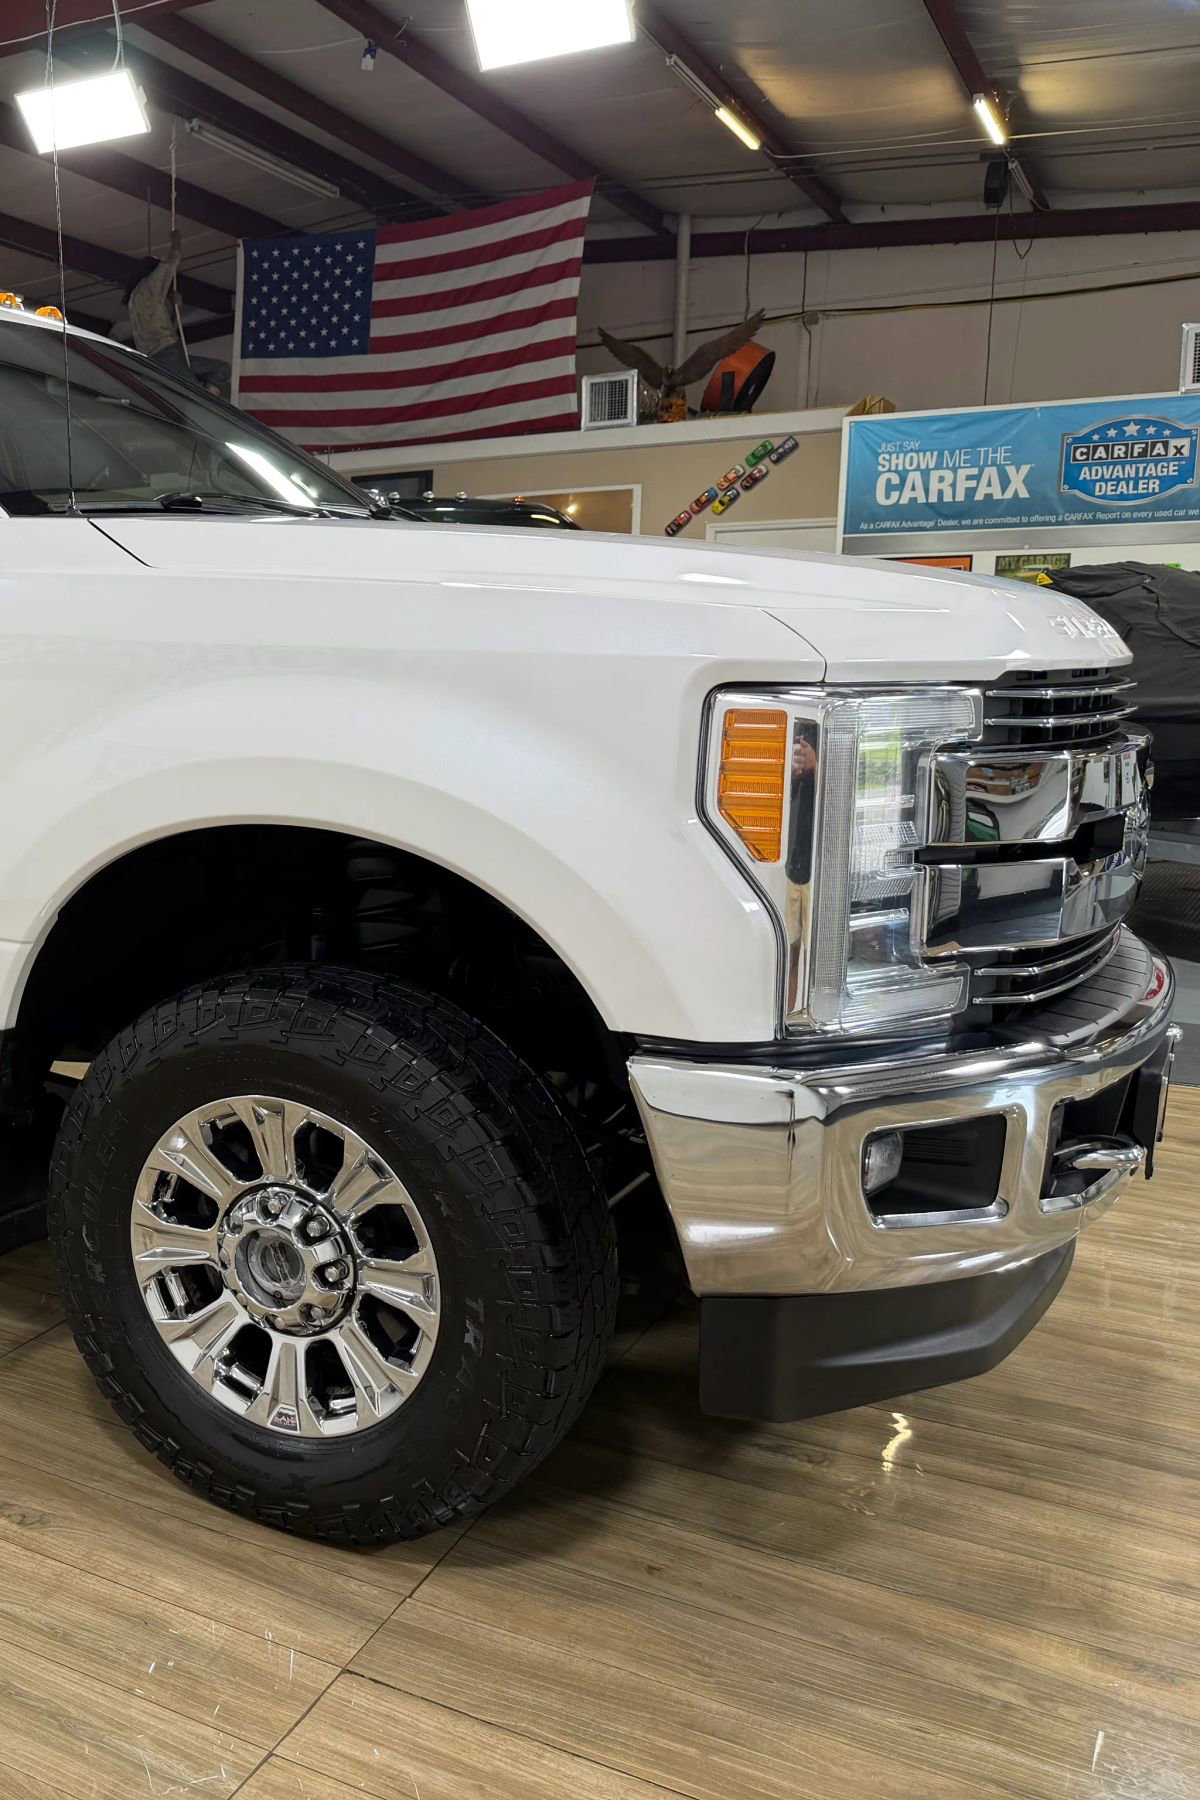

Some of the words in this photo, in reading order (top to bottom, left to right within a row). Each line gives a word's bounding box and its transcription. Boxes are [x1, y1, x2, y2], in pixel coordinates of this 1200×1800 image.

[880, 442, 900, 453] JUST
[903, 440, 920, 451] SAY
[1075, 442, 1186, 461] CARFAX
[878, 451, 938, 472] SHOW
[943, 449, 972, 468] ME
[978, 446, 1013, 465] THE
[1079, 461, 1179, 481] ADVANTAGE
[875, 464, 1031, 506] CARFAX
[1095, 479, 1161, 496] DEALER
[875, 520, 900, 529] CARFAX
[984, 515, 1020, 525] committed
[1021, 515, 1029, 523] to
[1029, 514, 1056, 524] offering
[1096, 511, 1120, 521] Report
[1133, 510, 1152, 520] every
[1154, 509, 1172, 517] used
[1174, 508, 1186, 516] car
[999, 556, 1016, 570] MY
[1020, 554, 1068, 570] GARAGE
